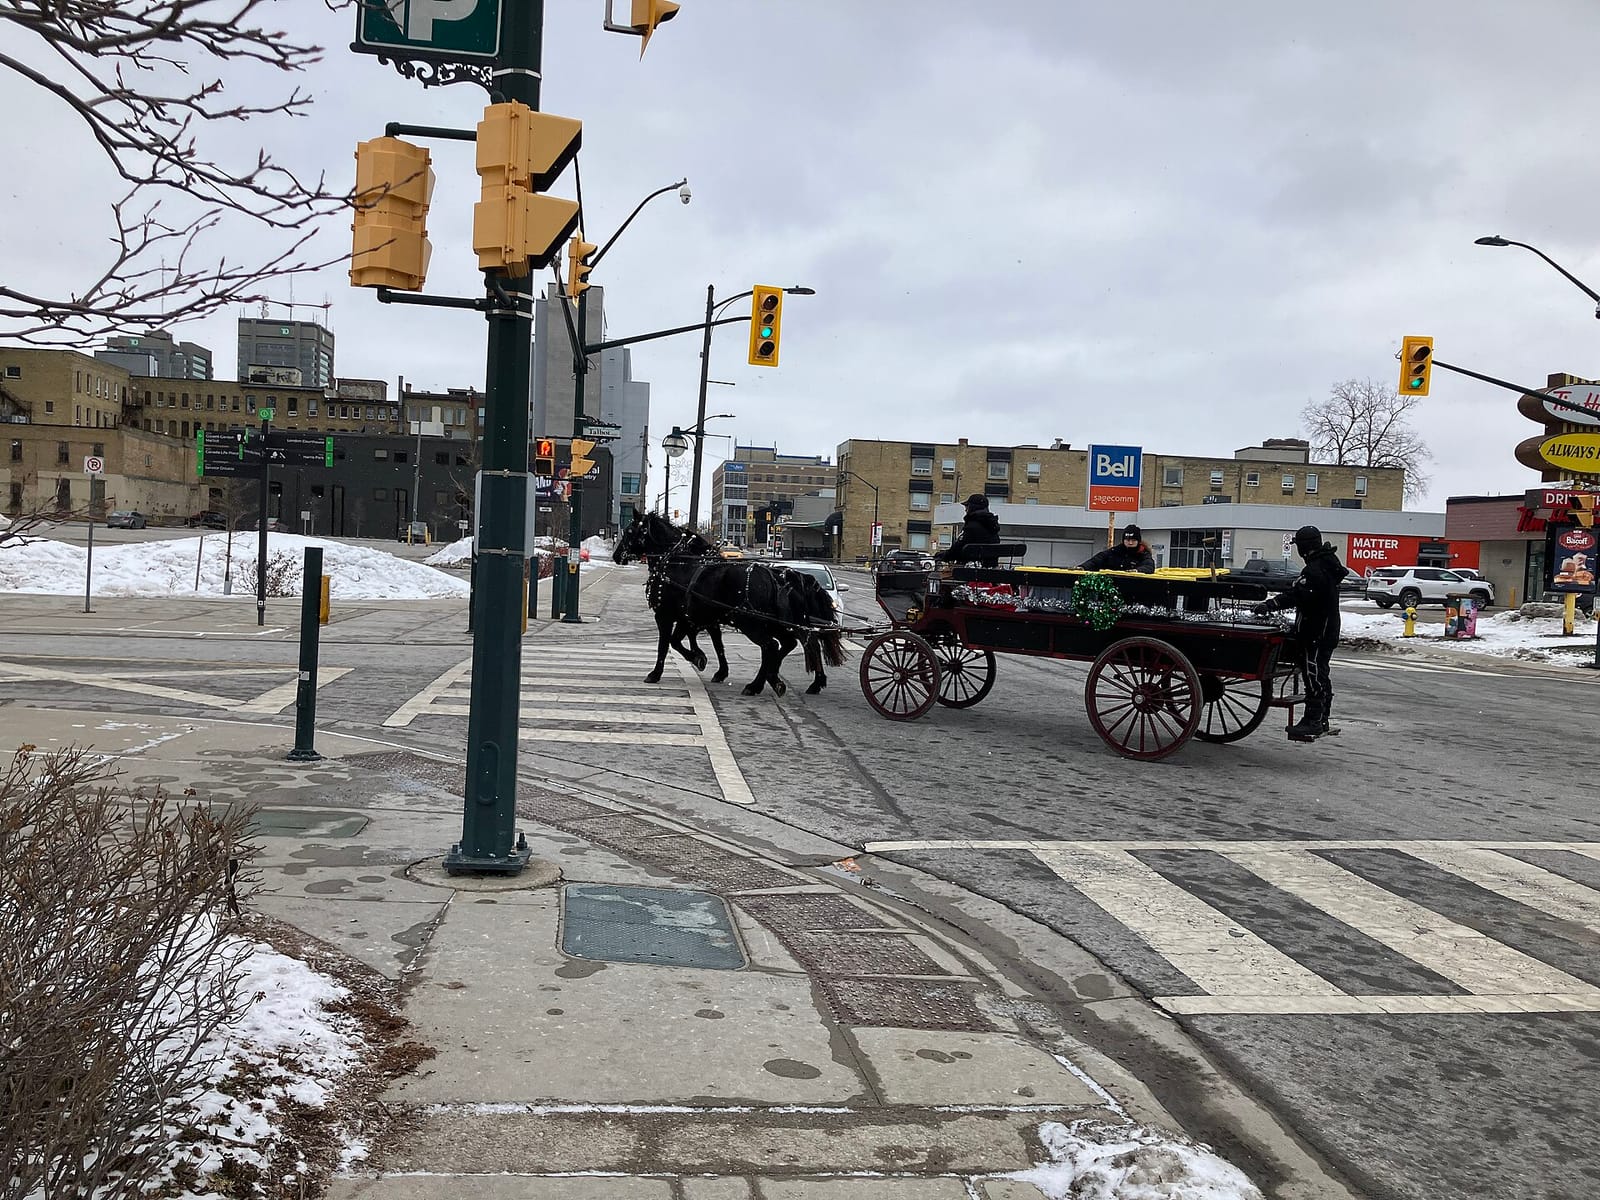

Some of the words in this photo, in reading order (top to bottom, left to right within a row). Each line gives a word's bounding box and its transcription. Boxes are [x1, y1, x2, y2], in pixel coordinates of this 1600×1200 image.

[1546, 443, 1595, 460] ALWAYS
[1096, 454, 1135, 478] Bell
[1094, 494, 1135, 505] sagecomm
[1353, 537, 1399, 549] MATTER
[1352, 549, 1388, 560] MORE.
